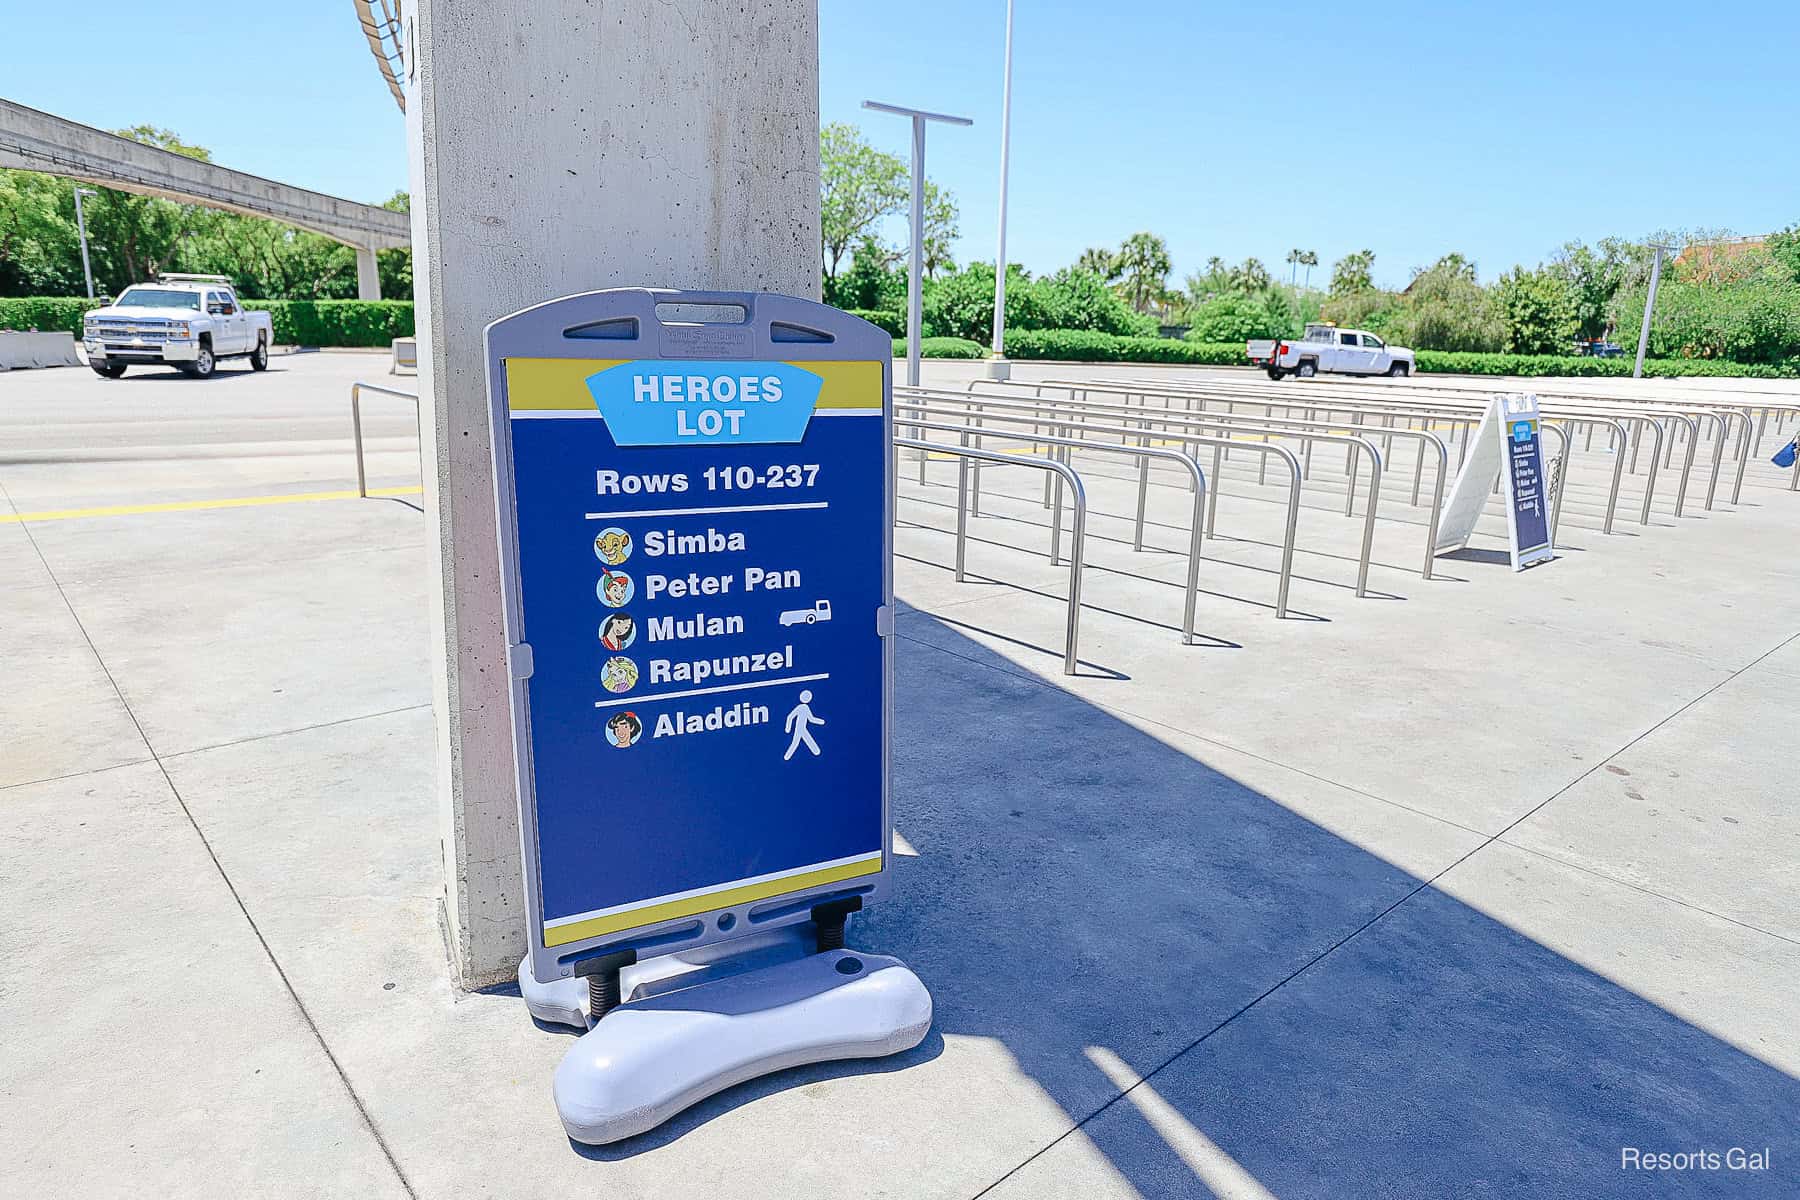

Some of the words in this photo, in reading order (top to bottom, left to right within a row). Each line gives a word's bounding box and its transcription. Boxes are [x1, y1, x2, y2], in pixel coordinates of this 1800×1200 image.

[634, 376, 782, 403] HEROES
[677, 410, 746, 436] LOT
[596, 471, 688, 495] Rows
[704, 464, 819, 491] 110-237
[644, 529, 746, 557] Simba
[646, 574, 733, 600] Peter
[745, 567, 801, 592] Pan
[647, 614, 744, 642] Mulan
[649, 646, 794, 684] Rapunzel
[653, 703, 769, 738] Aladdin
